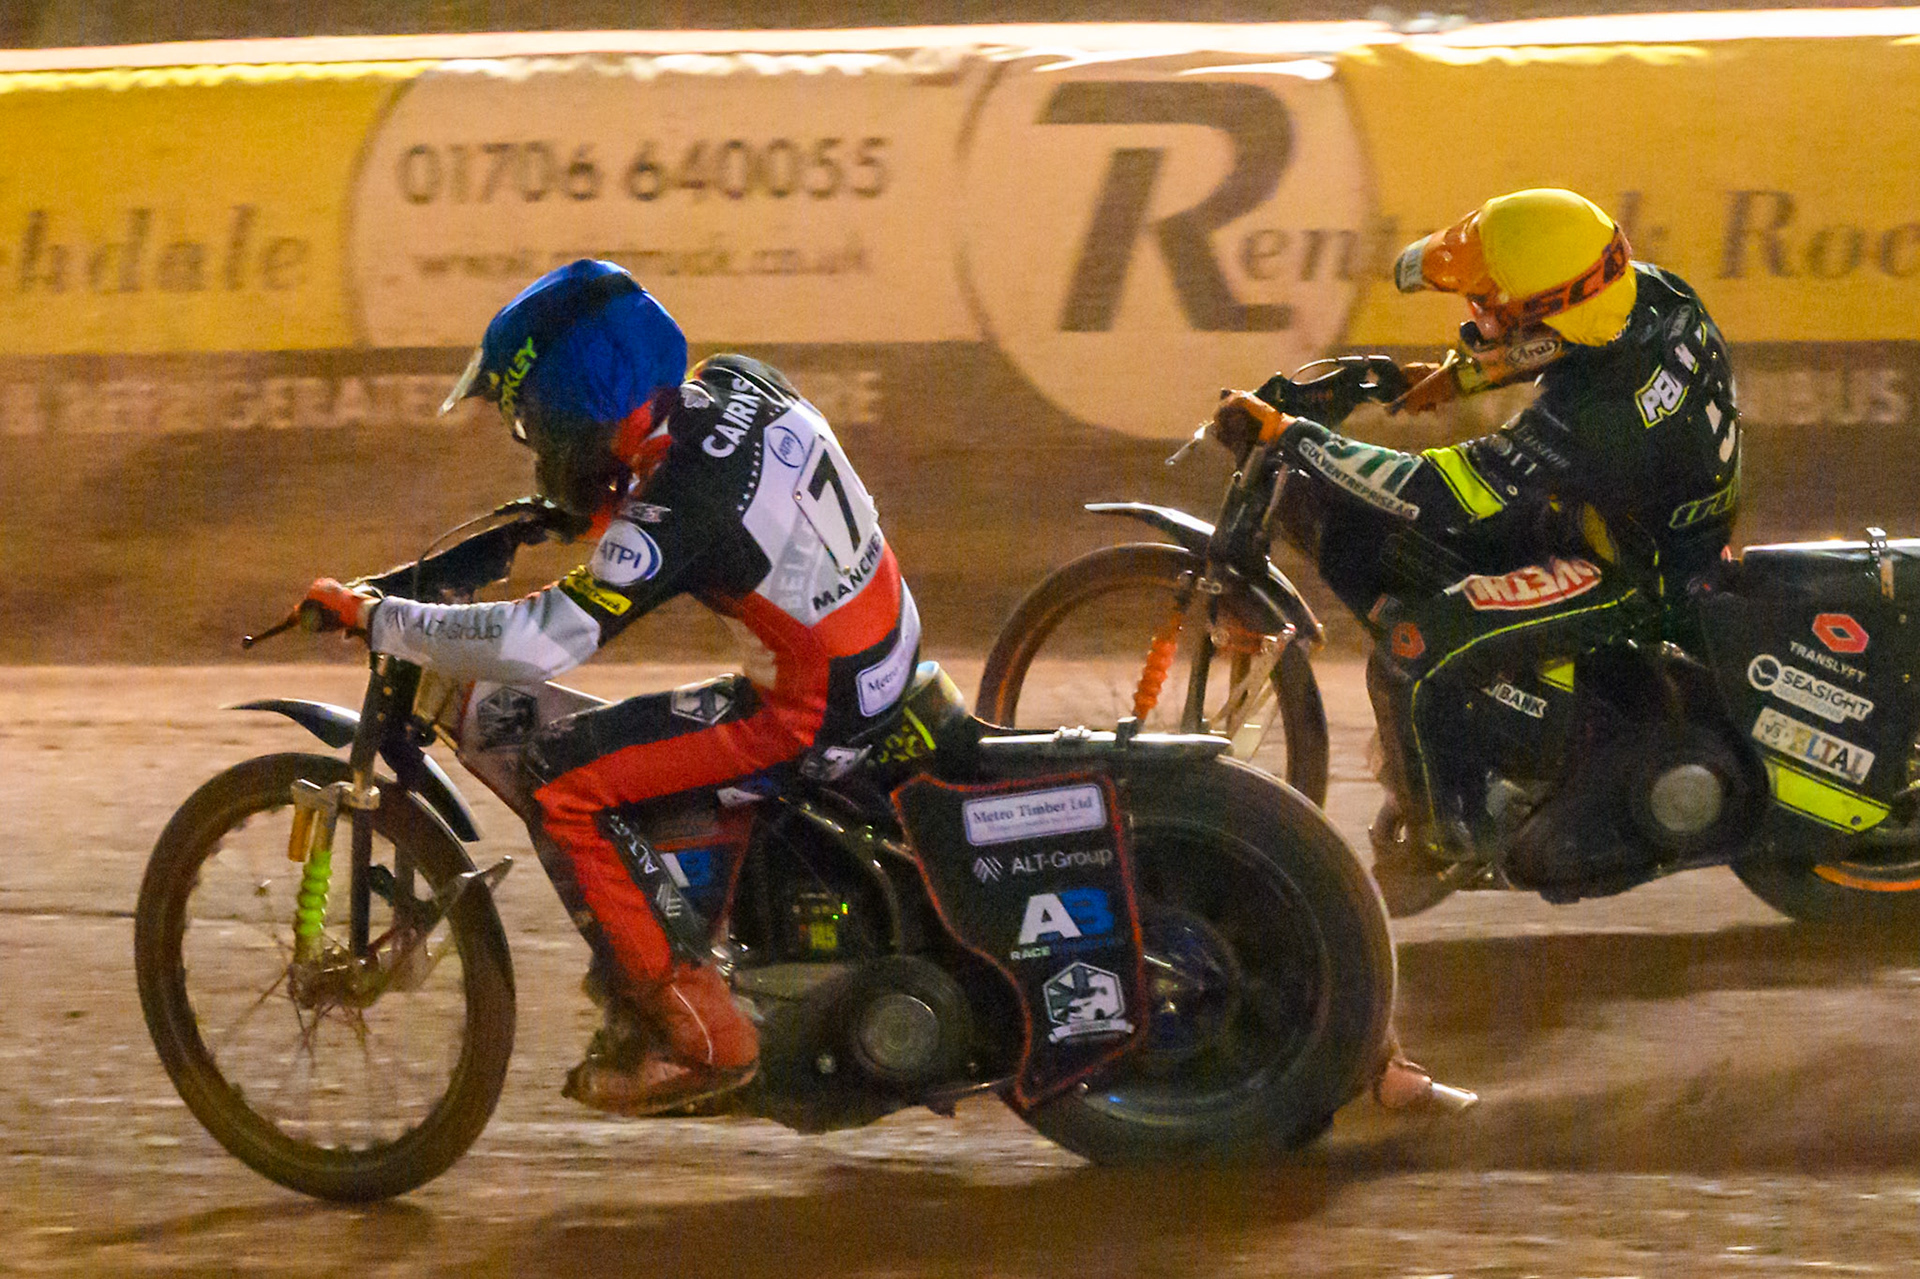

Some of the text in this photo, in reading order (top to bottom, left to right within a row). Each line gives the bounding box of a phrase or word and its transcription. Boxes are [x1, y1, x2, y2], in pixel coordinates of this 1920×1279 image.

[402, 136, 890, 204] 01706 640055
[0, 202, 312, 294] hdale
[702, 378, 760, 457] CAIRNS
[808, 449, 861, 553] 7
[1790, 640, 1867, 683] TRANSLYFT
[1782, 669, 1870, 716] SEASIGHT
[973, 808, 1014, 825] Metro
[1019, 802, 1067, 819] Timber
[1071, 796, 1093, 811] Ltd
[1012, 849, 1113, 875] ALT-Group
[1010, 946, 1050, 961] RACE
